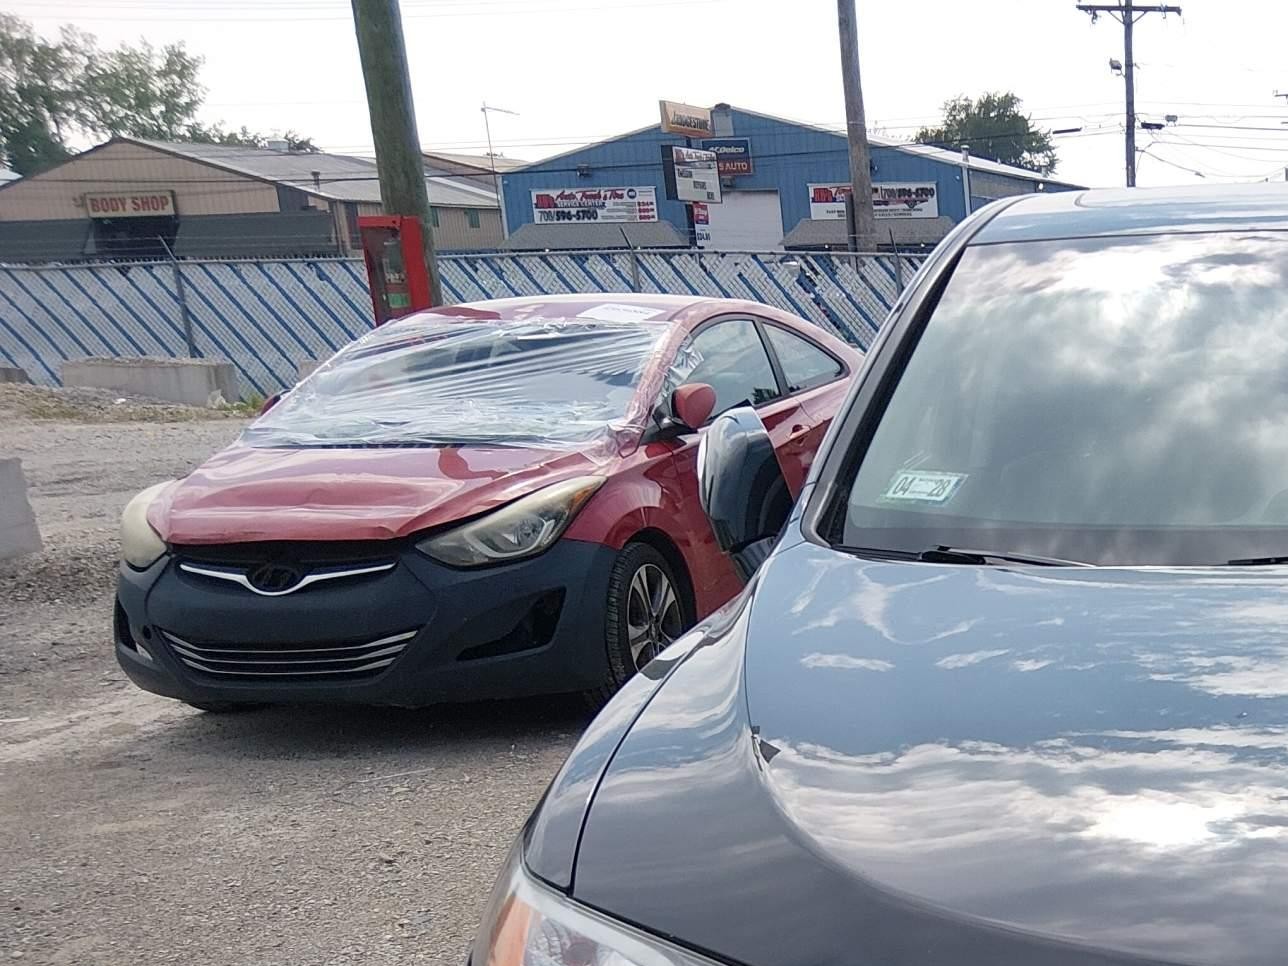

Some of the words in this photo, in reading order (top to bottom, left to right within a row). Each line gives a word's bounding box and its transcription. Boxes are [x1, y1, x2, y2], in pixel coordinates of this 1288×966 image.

[725, 162, 748, 170] AUTO
[89, 196, 127, 213] BODY
[131, 195, 169, 211] SHOP
[892, 476, 917, 496] 04
